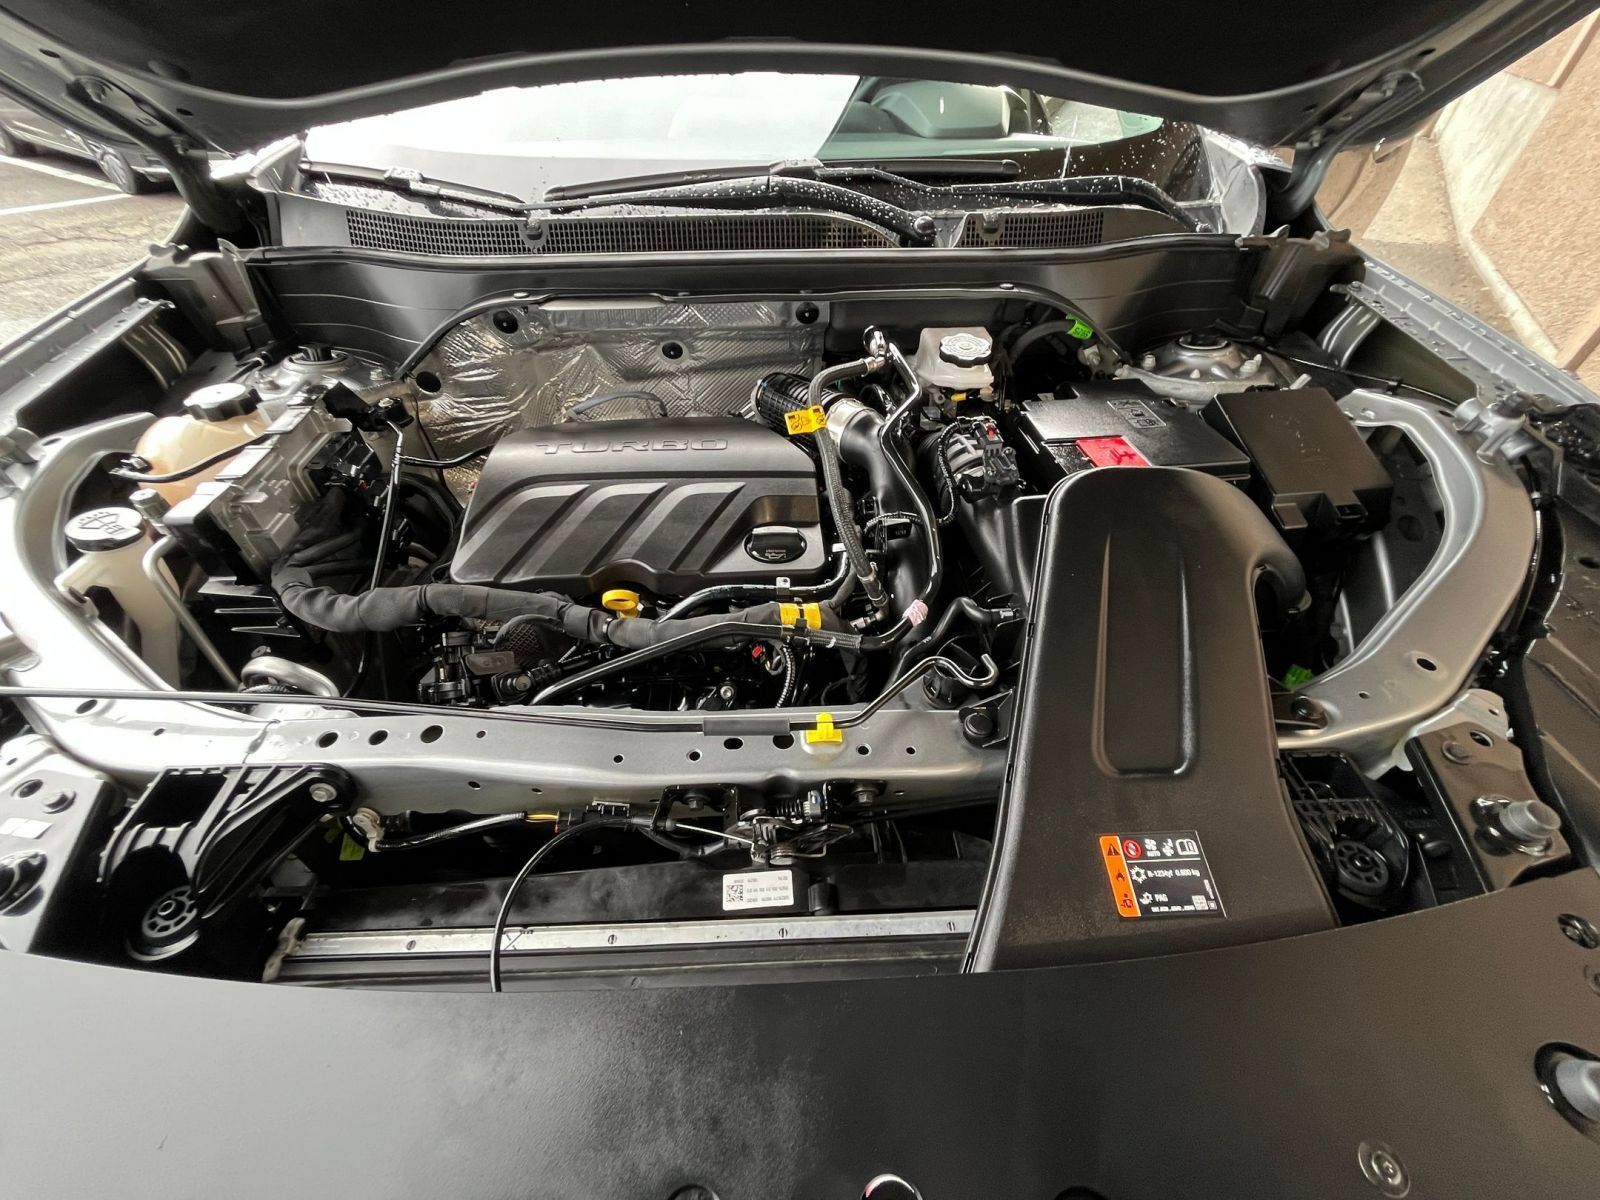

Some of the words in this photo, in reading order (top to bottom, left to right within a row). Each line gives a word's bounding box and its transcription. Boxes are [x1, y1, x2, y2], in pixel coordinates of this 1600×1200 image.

[536, 439, 728, 454] TURBO
[1191, 868, 1201, 877] kg
[1154, 893, 1169, 902] PAG
